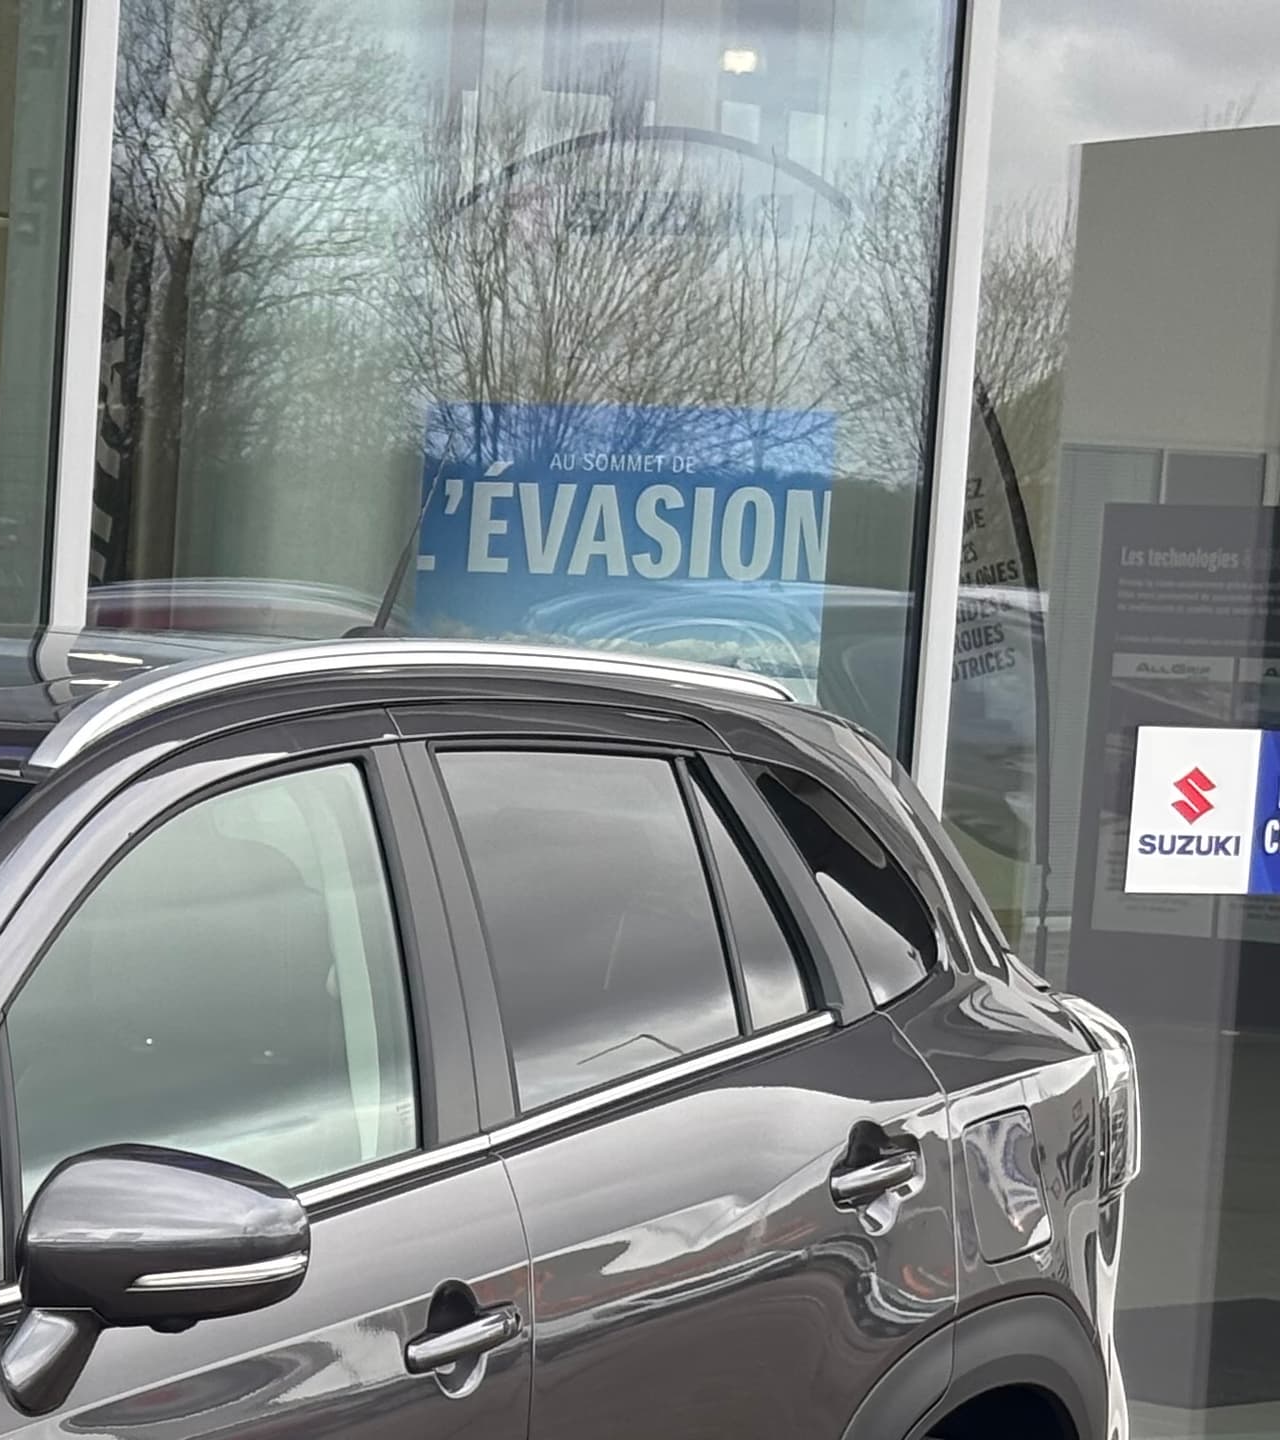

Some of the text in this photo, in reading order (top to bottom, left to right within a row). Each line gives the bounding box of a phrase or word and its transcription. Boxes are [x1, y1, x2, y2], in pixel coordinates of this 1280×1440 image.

[549, 453, 696, 475] AU SOMMET DE
[1120, 545, 1144, 567] Les
[1148, 547, 1240, 573] technologies
[1137, 834, 1242, 857] SUZUKI
